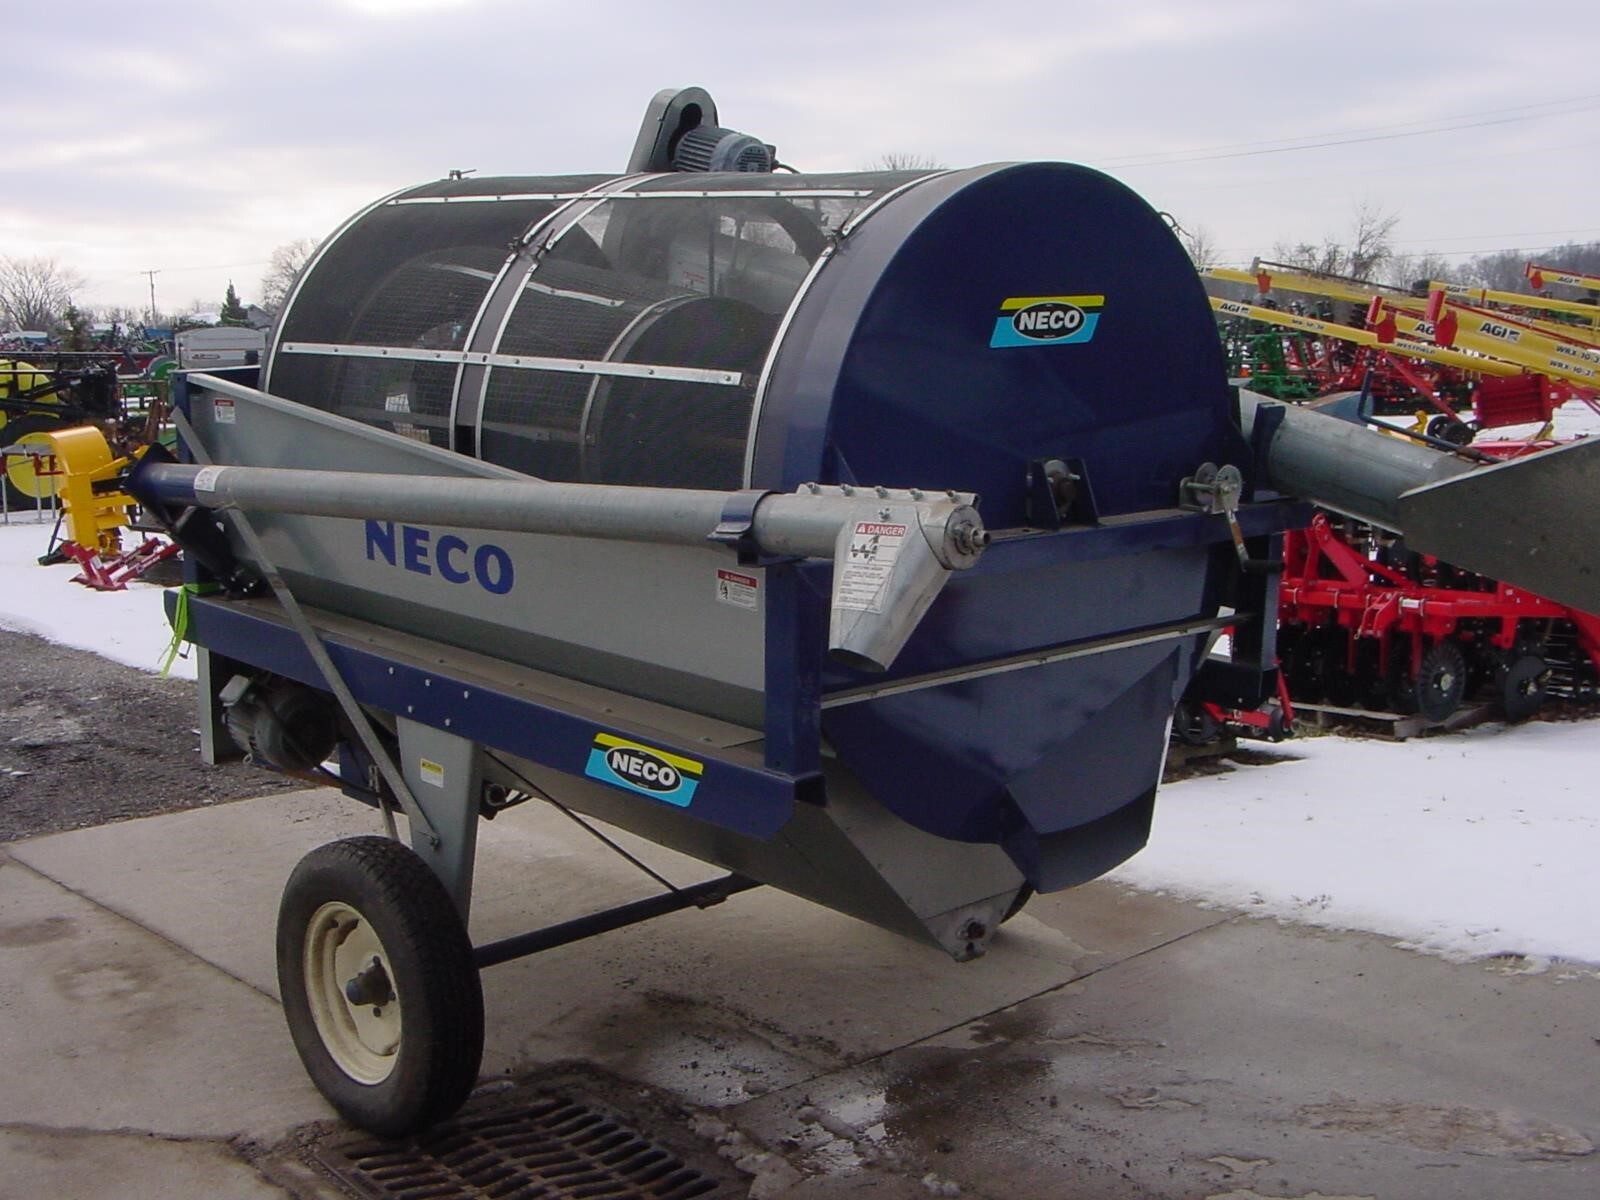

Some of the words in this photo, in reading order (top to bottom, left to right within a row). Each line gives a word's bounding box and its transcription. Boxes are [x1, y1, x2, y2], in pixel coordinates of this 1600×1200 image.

[1219, 302, 1240, 313] AGI
[1018, 309, 1081, 331] NECO
[1414, 322, 1435, 336] AG
[1479, 322, 1508, 339] AGI
[867, 525, 905, 536] DANGER
[365, 518, 515, 595] NECO
[611, 751, 676, 787] NECO
